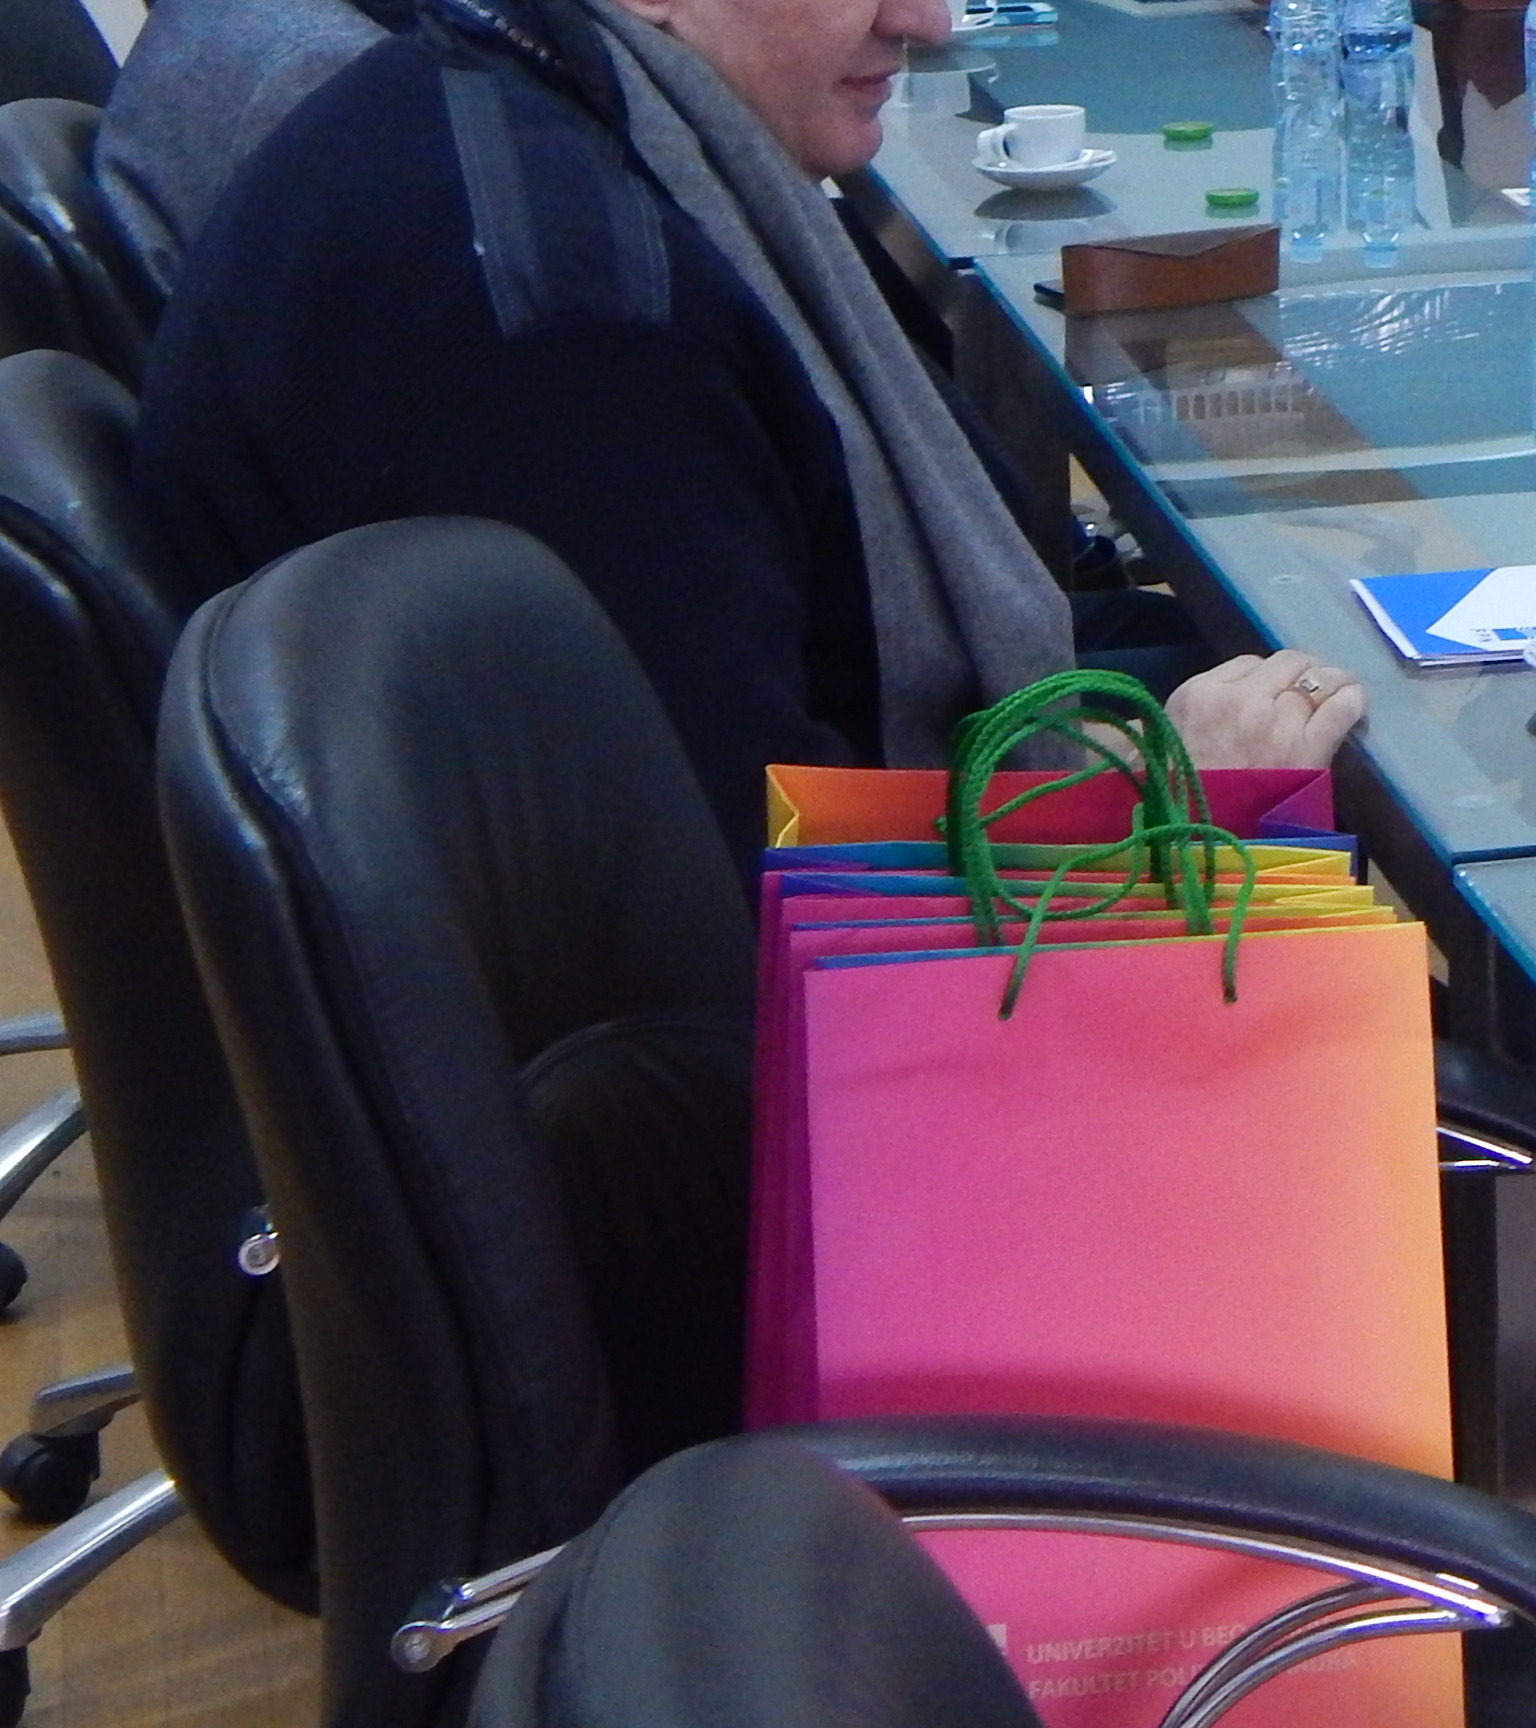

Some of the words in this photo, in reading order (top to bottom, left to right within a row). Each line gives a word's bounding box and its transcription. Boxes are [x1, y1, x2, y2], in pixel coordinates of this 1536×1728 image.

[1027, 1630, 1174, 1664] UNIVERZITET
[1178, 1628, 1196, 1649] U
[1027, 1671, 1139, 1700] FAKULTET
